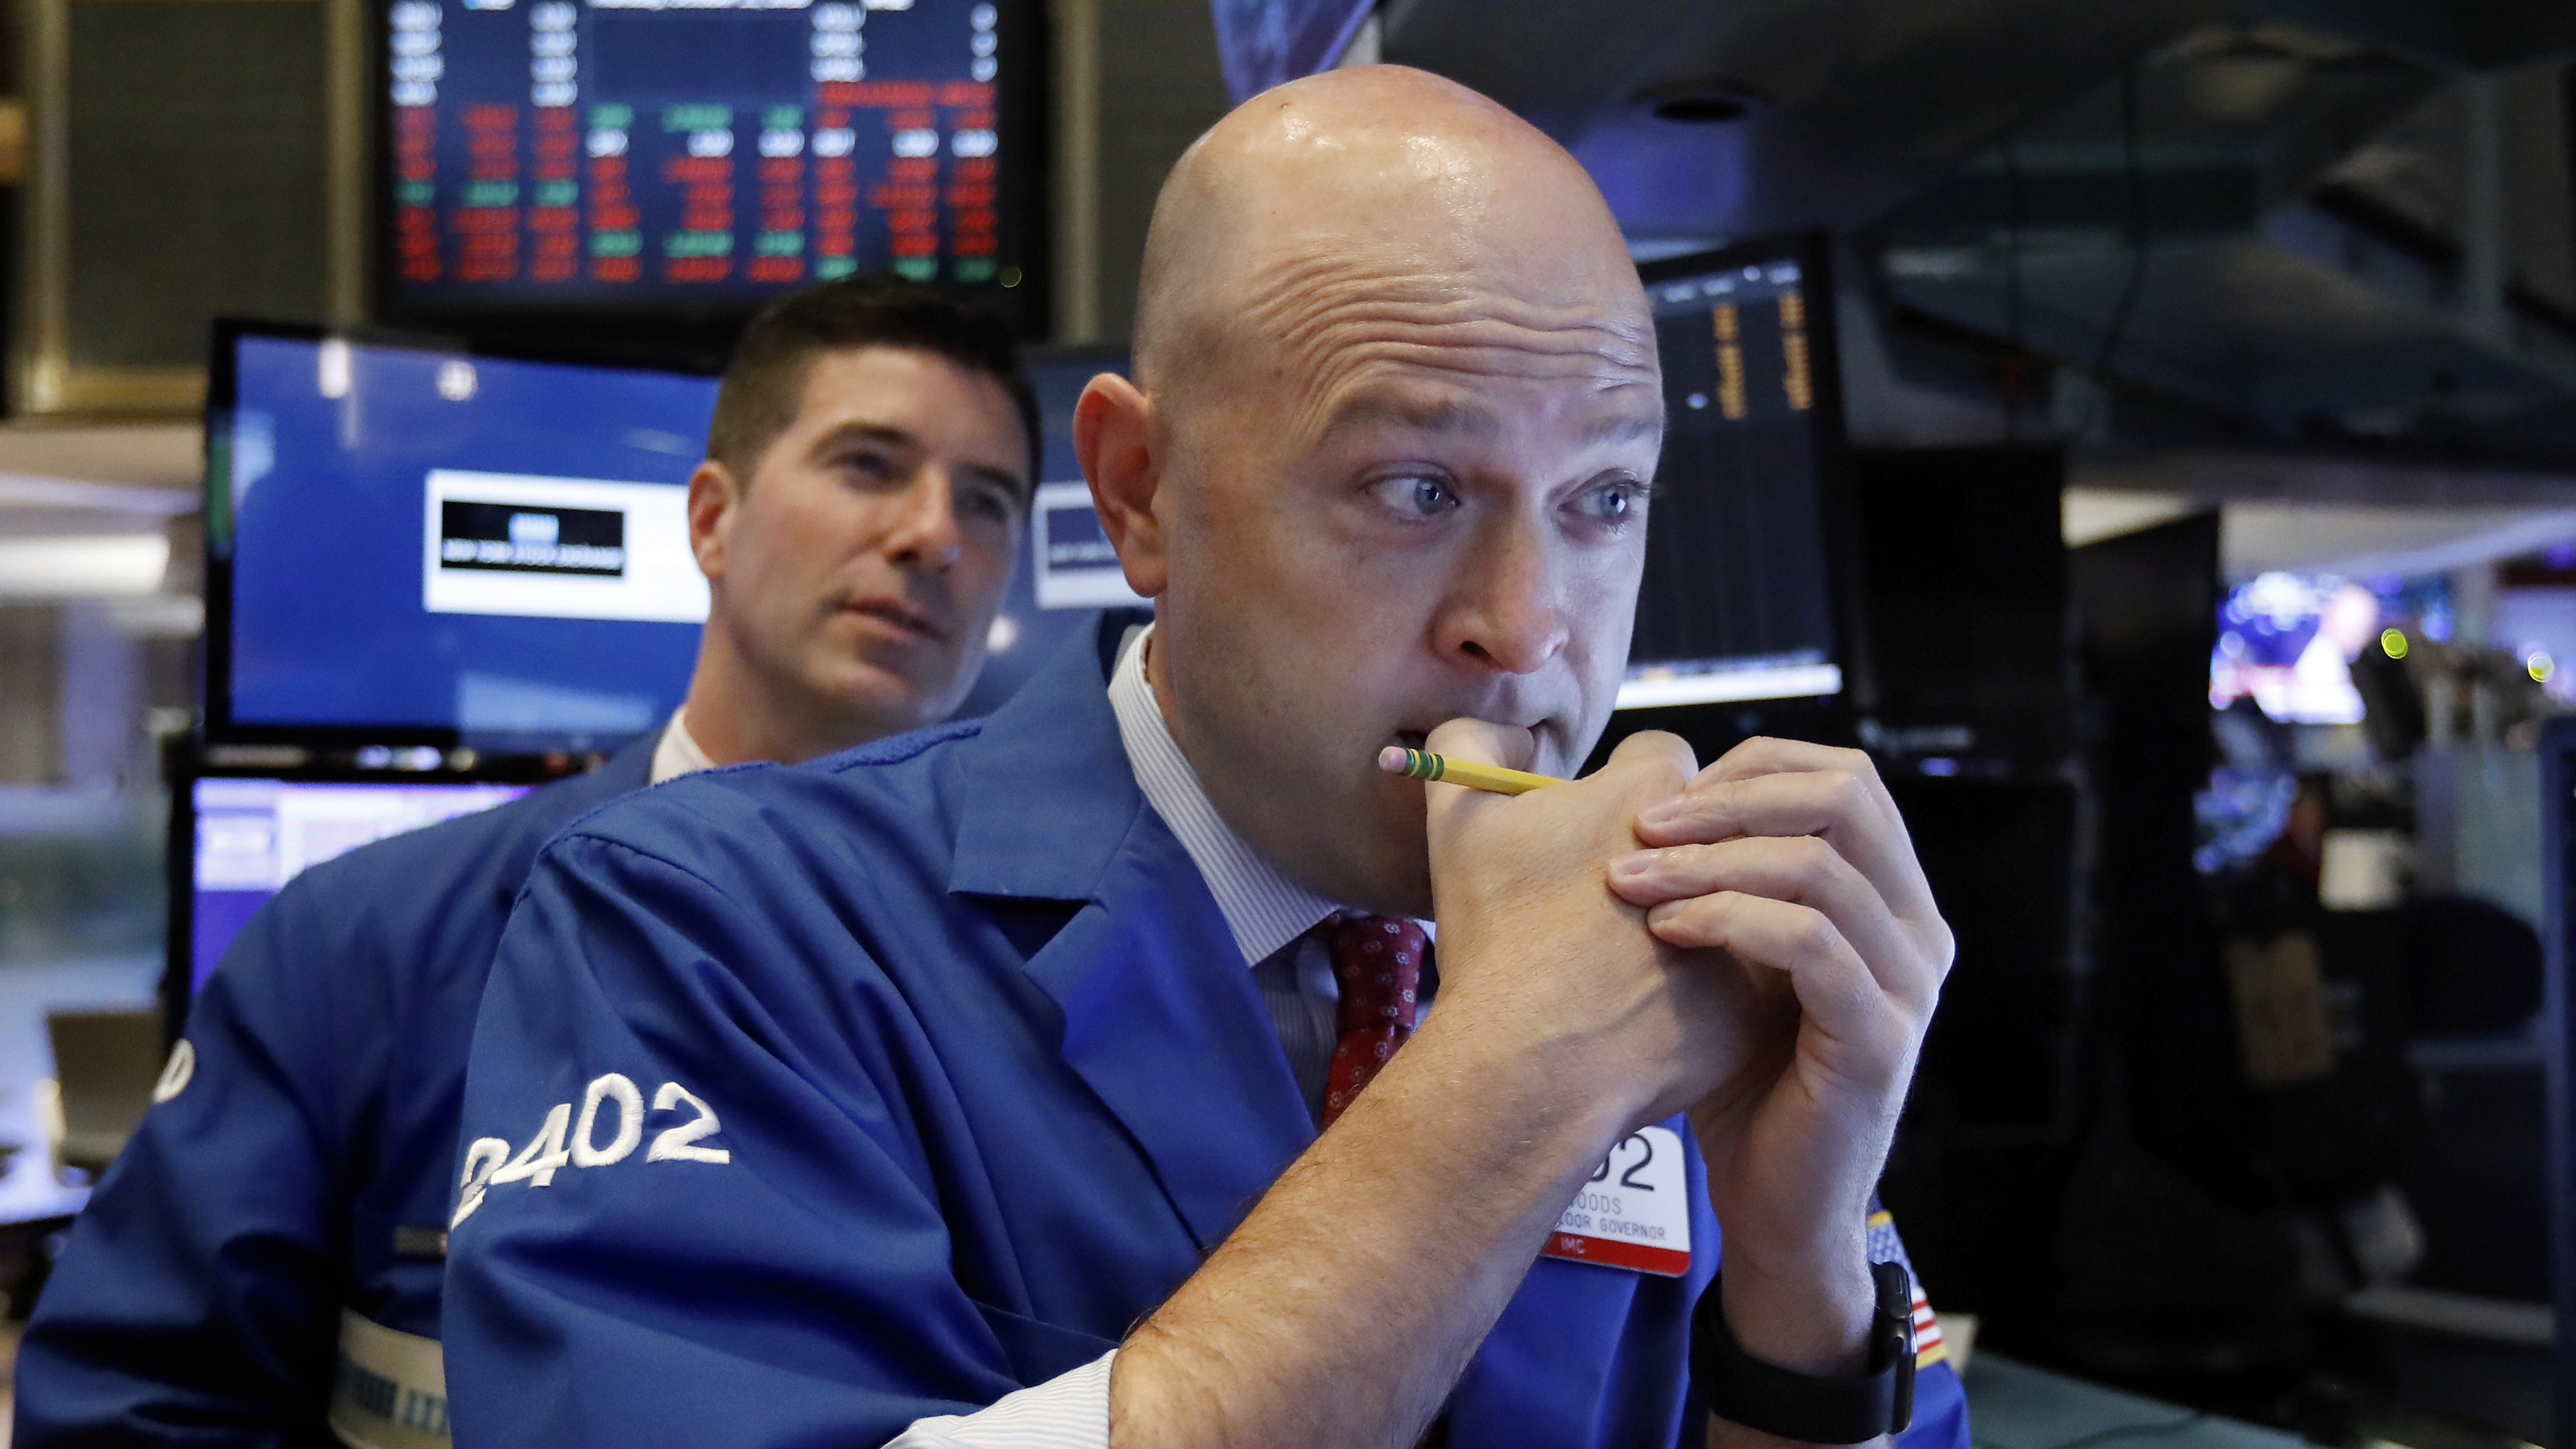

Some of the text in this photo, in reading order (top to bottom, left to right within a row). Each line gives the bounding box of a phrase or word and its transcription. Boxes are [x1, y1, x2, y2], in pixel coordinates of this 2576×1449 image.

[451, 1072, 731, 1231] 2402
[1571, 1191, 1622, 1215] OODS
[1558, 1212, 1665, 1241] LOOR GOVERNOR
